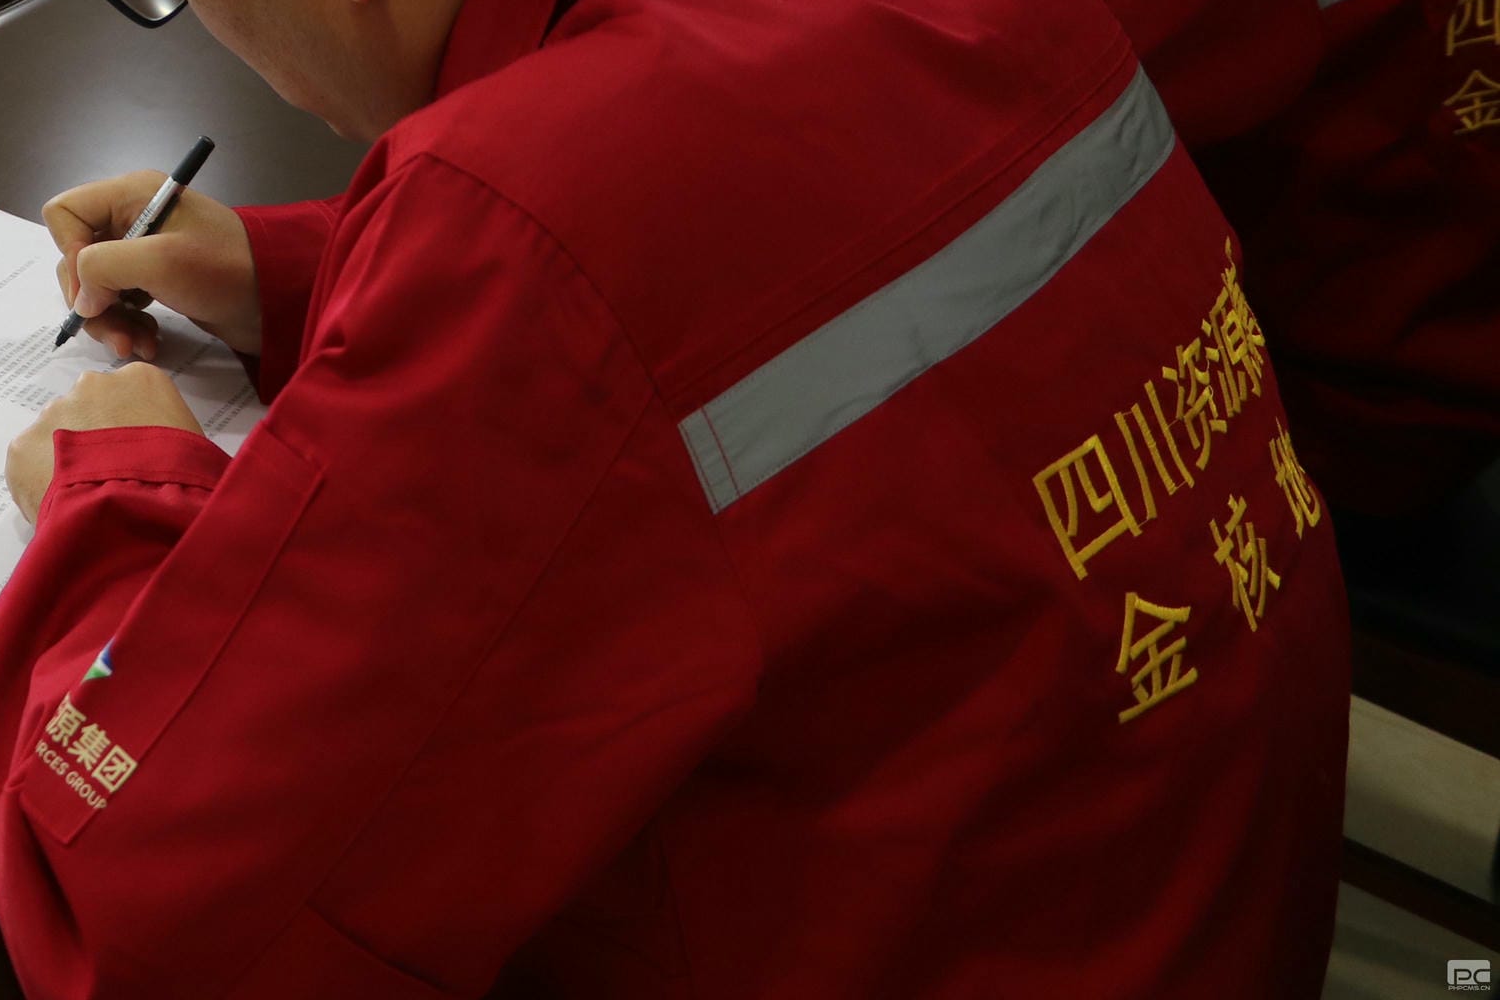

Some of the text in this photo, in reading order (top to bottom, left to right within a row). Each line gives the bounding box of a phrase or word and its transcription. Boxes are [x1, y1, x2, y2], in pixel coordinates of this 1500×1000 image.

[1443, 69, 1500, 135] 金
[35, 739, 108, 809] RCES GROUP
